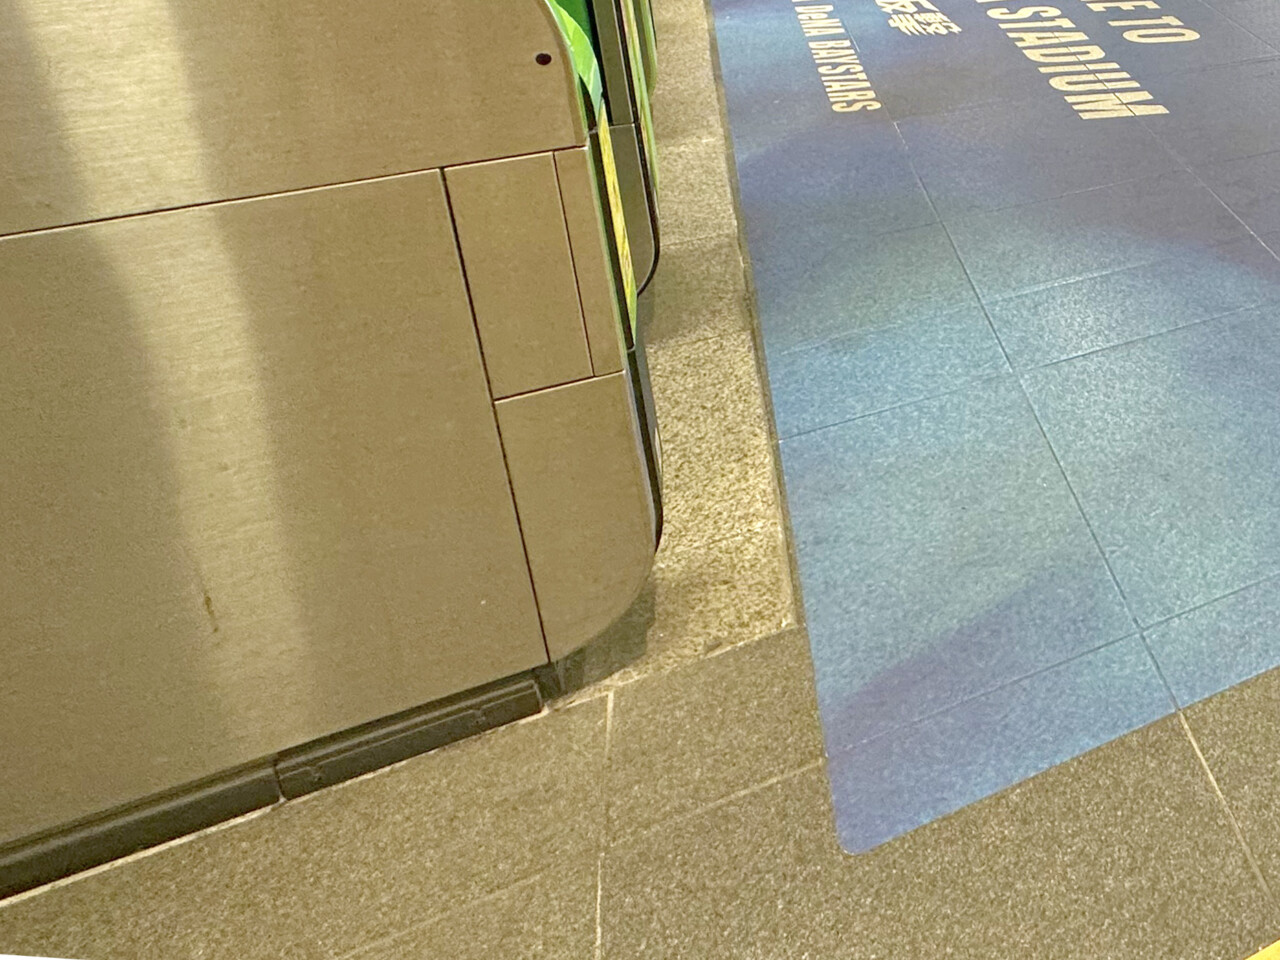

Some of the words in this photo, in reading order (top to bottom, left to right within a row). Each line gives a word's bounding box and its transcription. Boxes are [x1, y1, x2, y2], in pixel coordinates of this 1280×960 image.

[794, 4, 845, 38] DeNA
[1108, 16, 1201, 44] TO
[808, 38, 882, 113] BAYSTARS
[986, 6, 1170, 121] STADIUM
